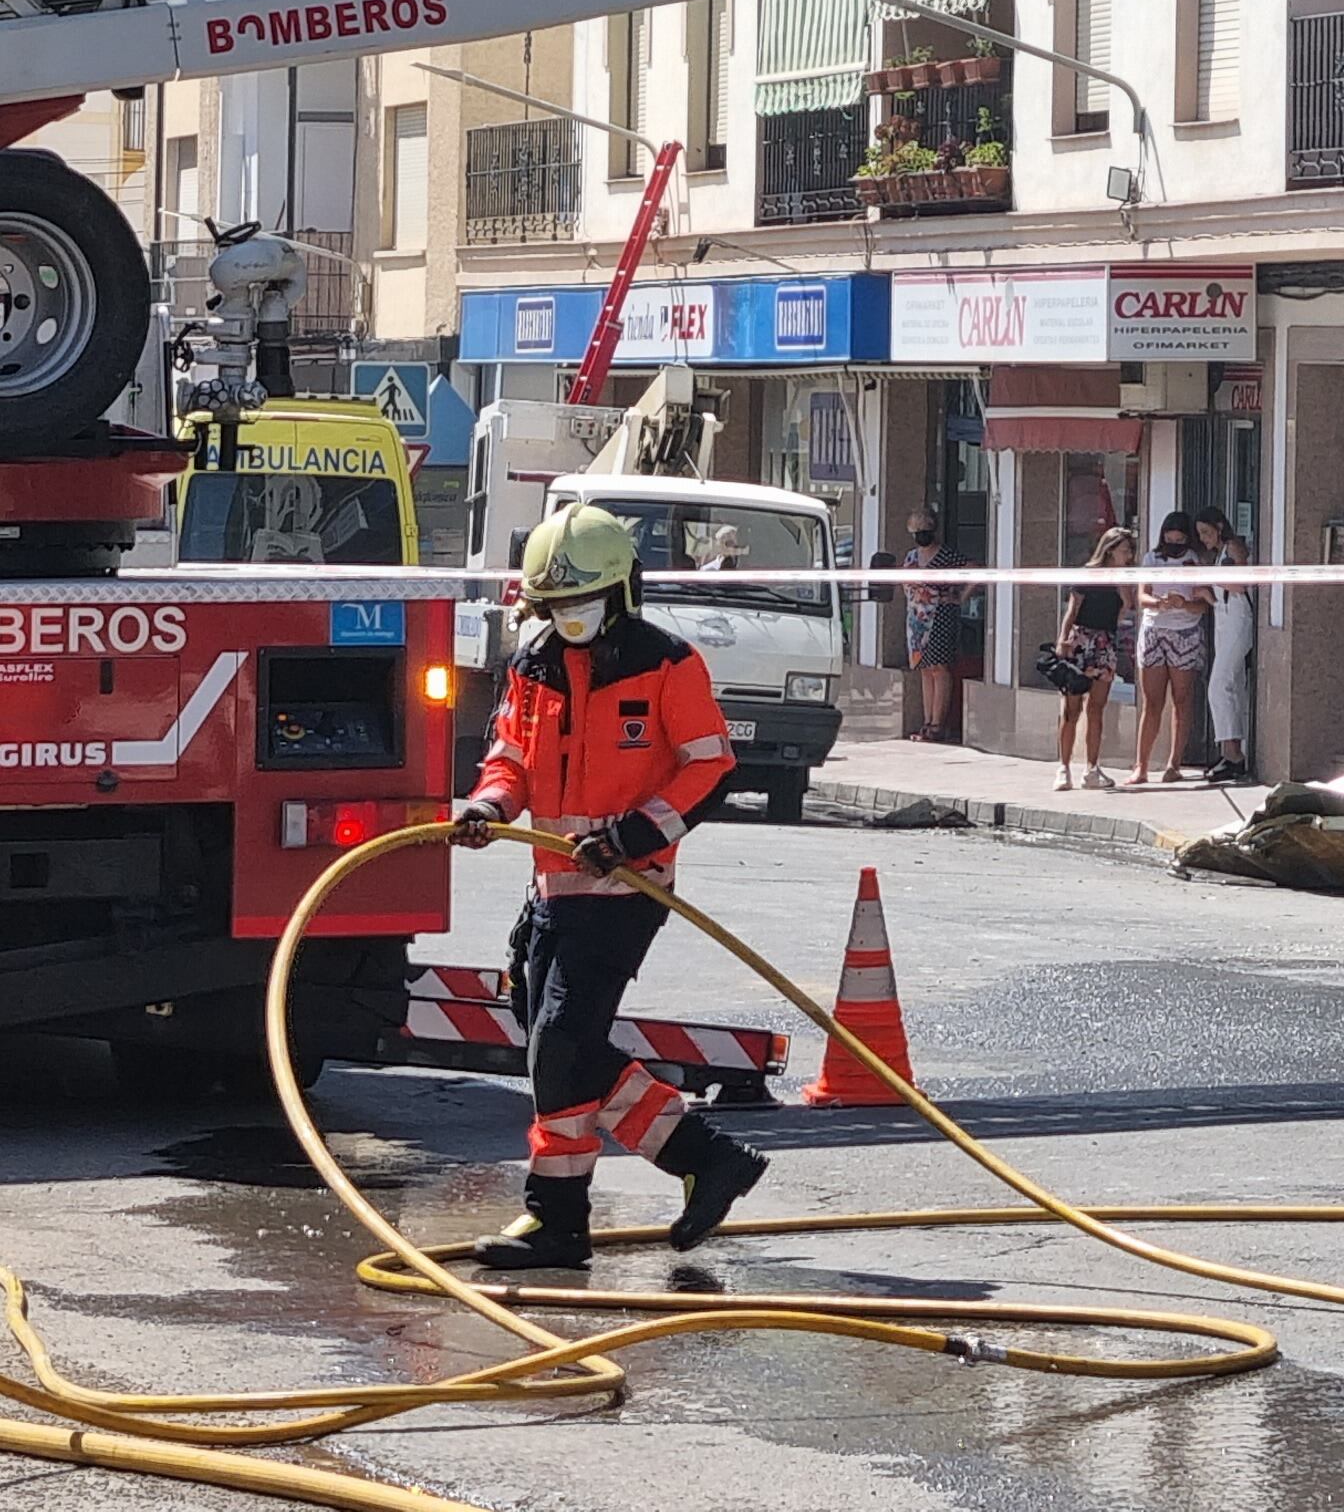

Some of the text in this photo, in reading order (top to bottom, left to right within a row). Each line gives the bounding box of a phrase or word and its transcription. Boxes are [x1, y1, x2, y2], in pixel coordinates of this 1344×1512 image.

[670, 304, 707, 340] FLEX
[1114, 326, 1248, 335] HIPERPAPELERIA
[1133, 341, 1230, 350] OFIMARKET
